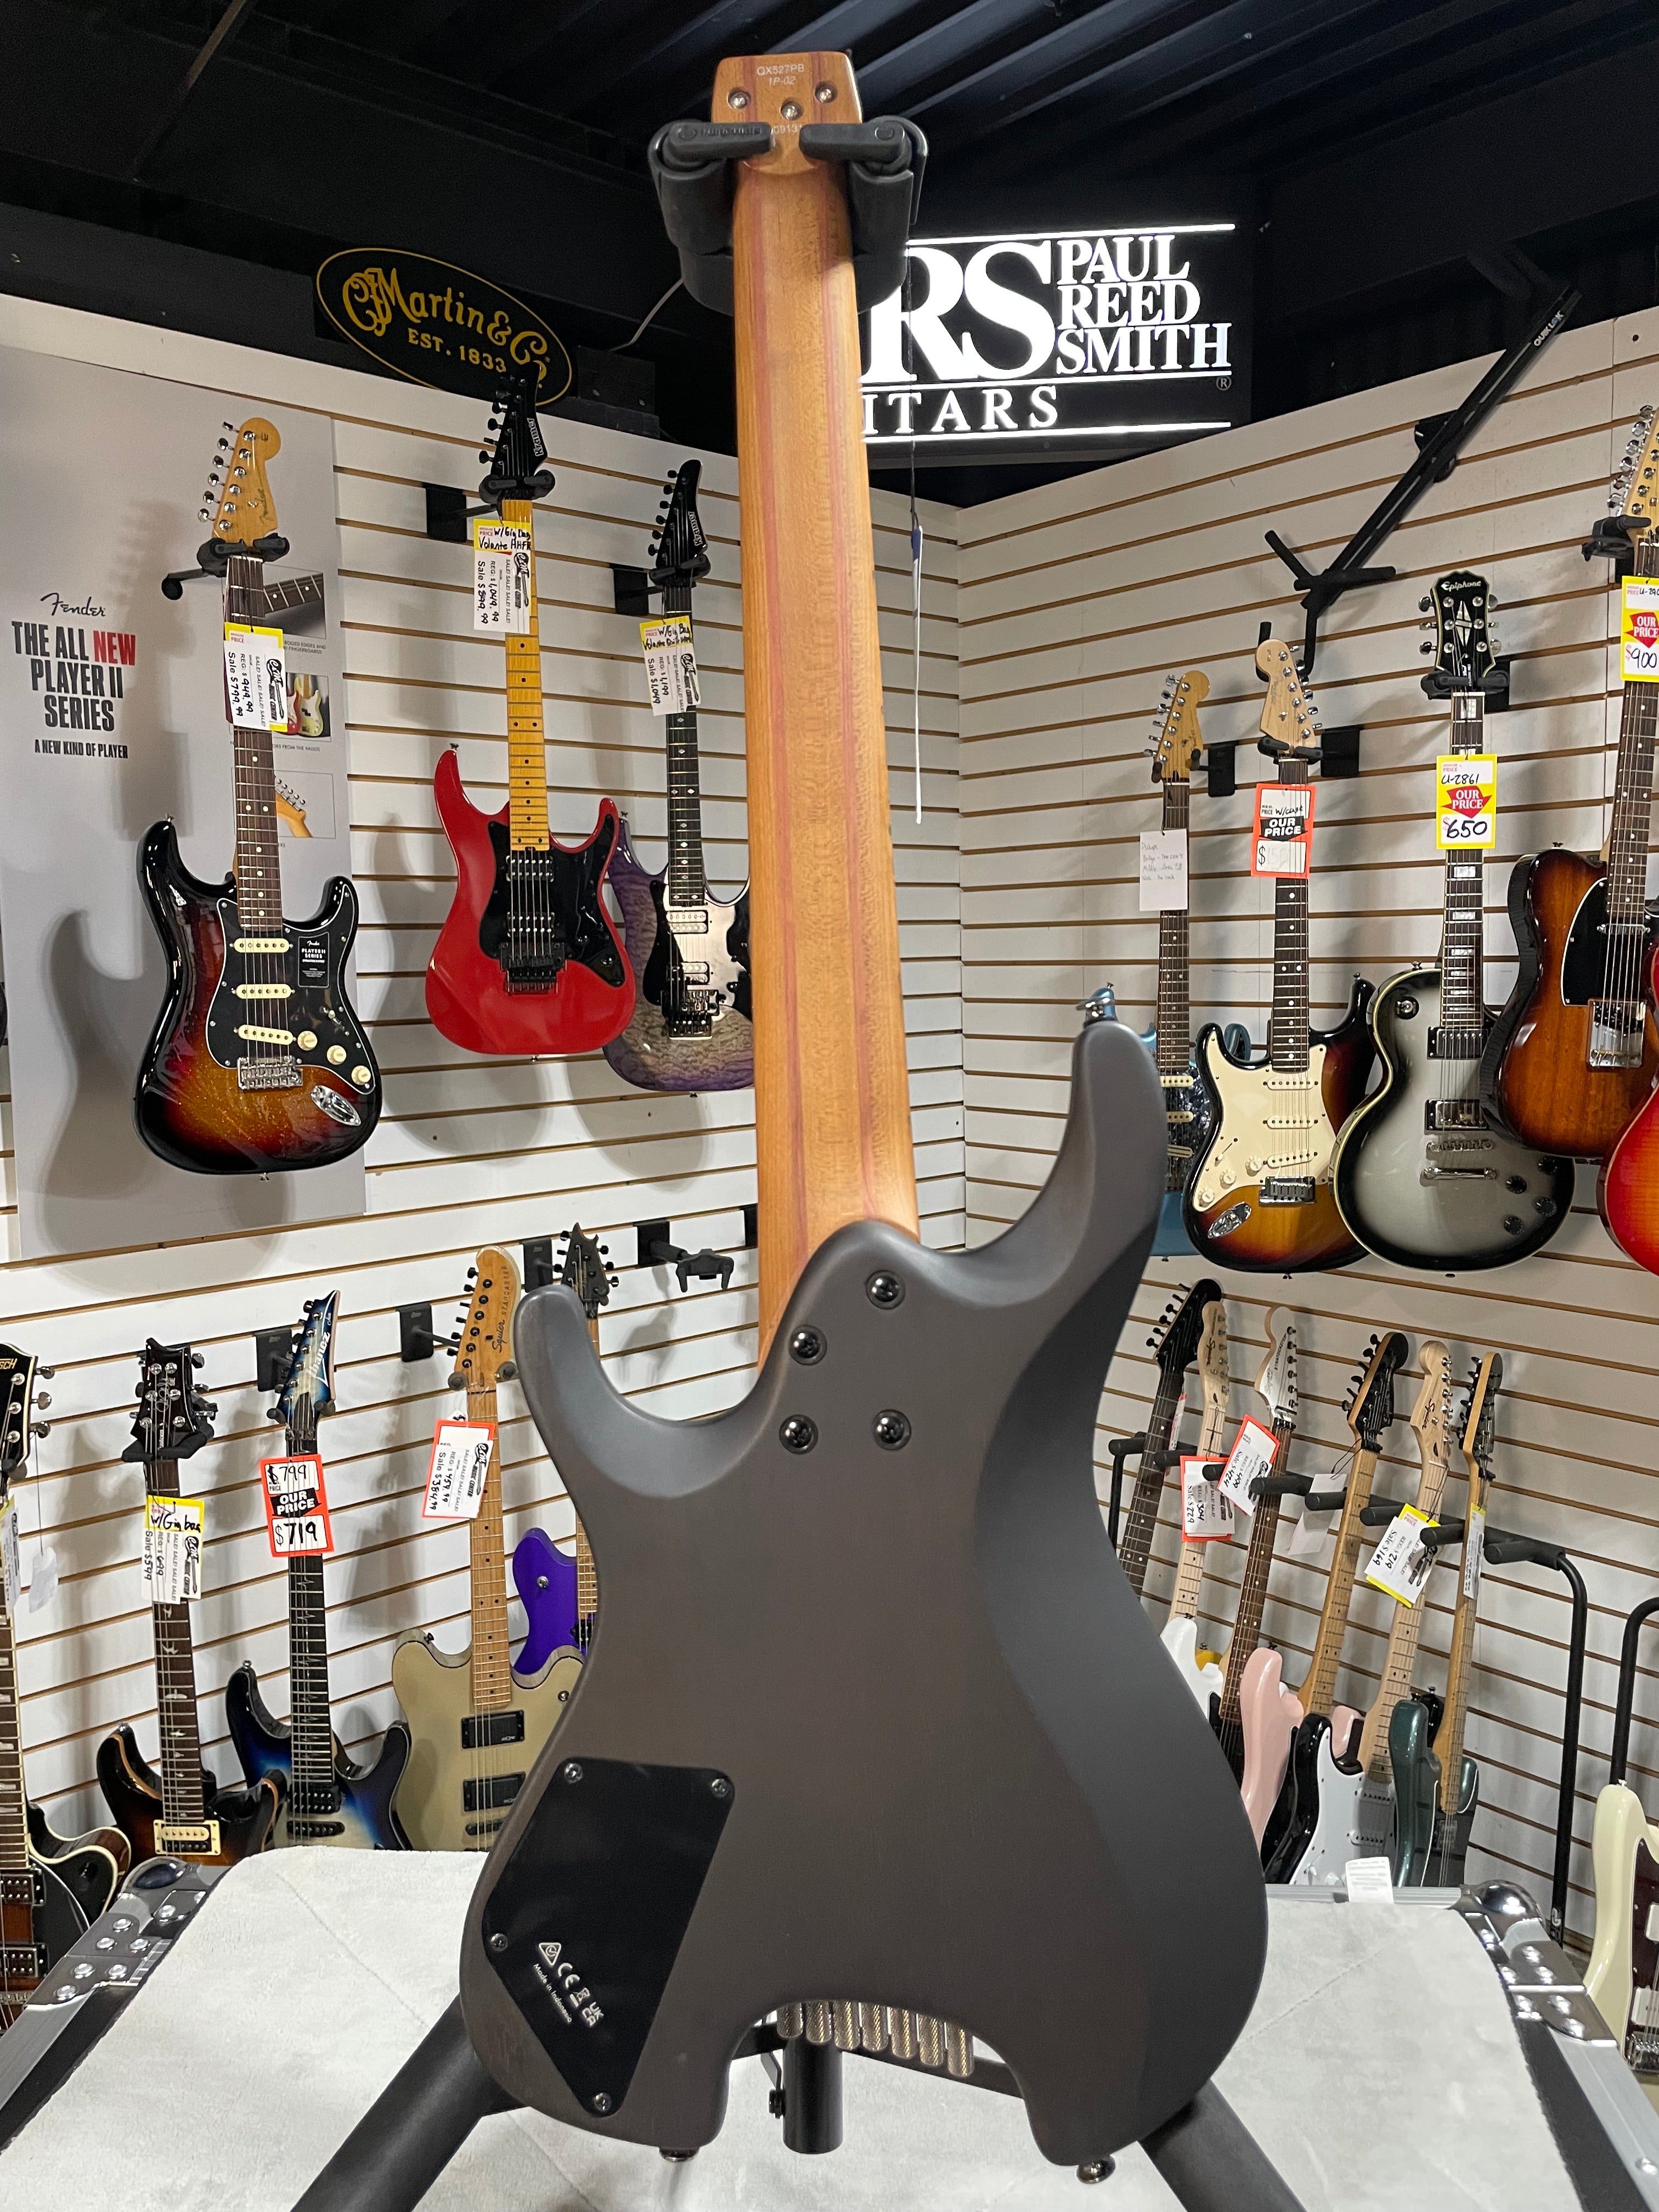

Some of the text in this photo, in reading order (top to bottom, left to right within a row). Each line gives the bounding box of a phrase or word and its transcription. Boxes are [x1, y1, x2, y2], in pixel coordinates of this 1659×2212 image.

[1057, 234, 1190, 285] PAUL
[860, 241, 1054, 383] RS
[1057, 278, 1201, 330] REED
[408, 328, 506, 373] EST. 1833
[1056, 323, 1232, 374] SMITH
[861, 386, 1058, 435] ITARS
[527, 417, 544, 456] Kramer
[1441, 580, 1481, 591] Epiphone
[41, 592, 106, 617] Fender
[1637, 616, 1656, 627] OUR
[1634, 627, 1659, 638] PRICE
[12, 620, 136, 666] THE ALL NEW
[31, 658, 123, 698] PLAYER II
[44, 694, 115, 732] SERIES
[35, 739, 128, 759] A NEW KIND OF PLAYER
[1452, 799, 1483, 809] PRICE
[1455, 789, 1480, 799] OUR
[1264, 826, 1301, 837] PRICE
[1269, 818, 1295, 828] OUR
[492, 1319, 507, 1353] Squier
[436, 1452, 446, 1470] Sale
[276, 1498, 315, 1515] PRICE
[279, 1491, 307, 1504] OUR
[1404, 1516, 1417, 1528] PRICE
[1386, 1530, 1397, 1545] Sale
[534, 1963, 572, 2023] Made in Indonesia
[590, 2002, 604, 2021] UK
